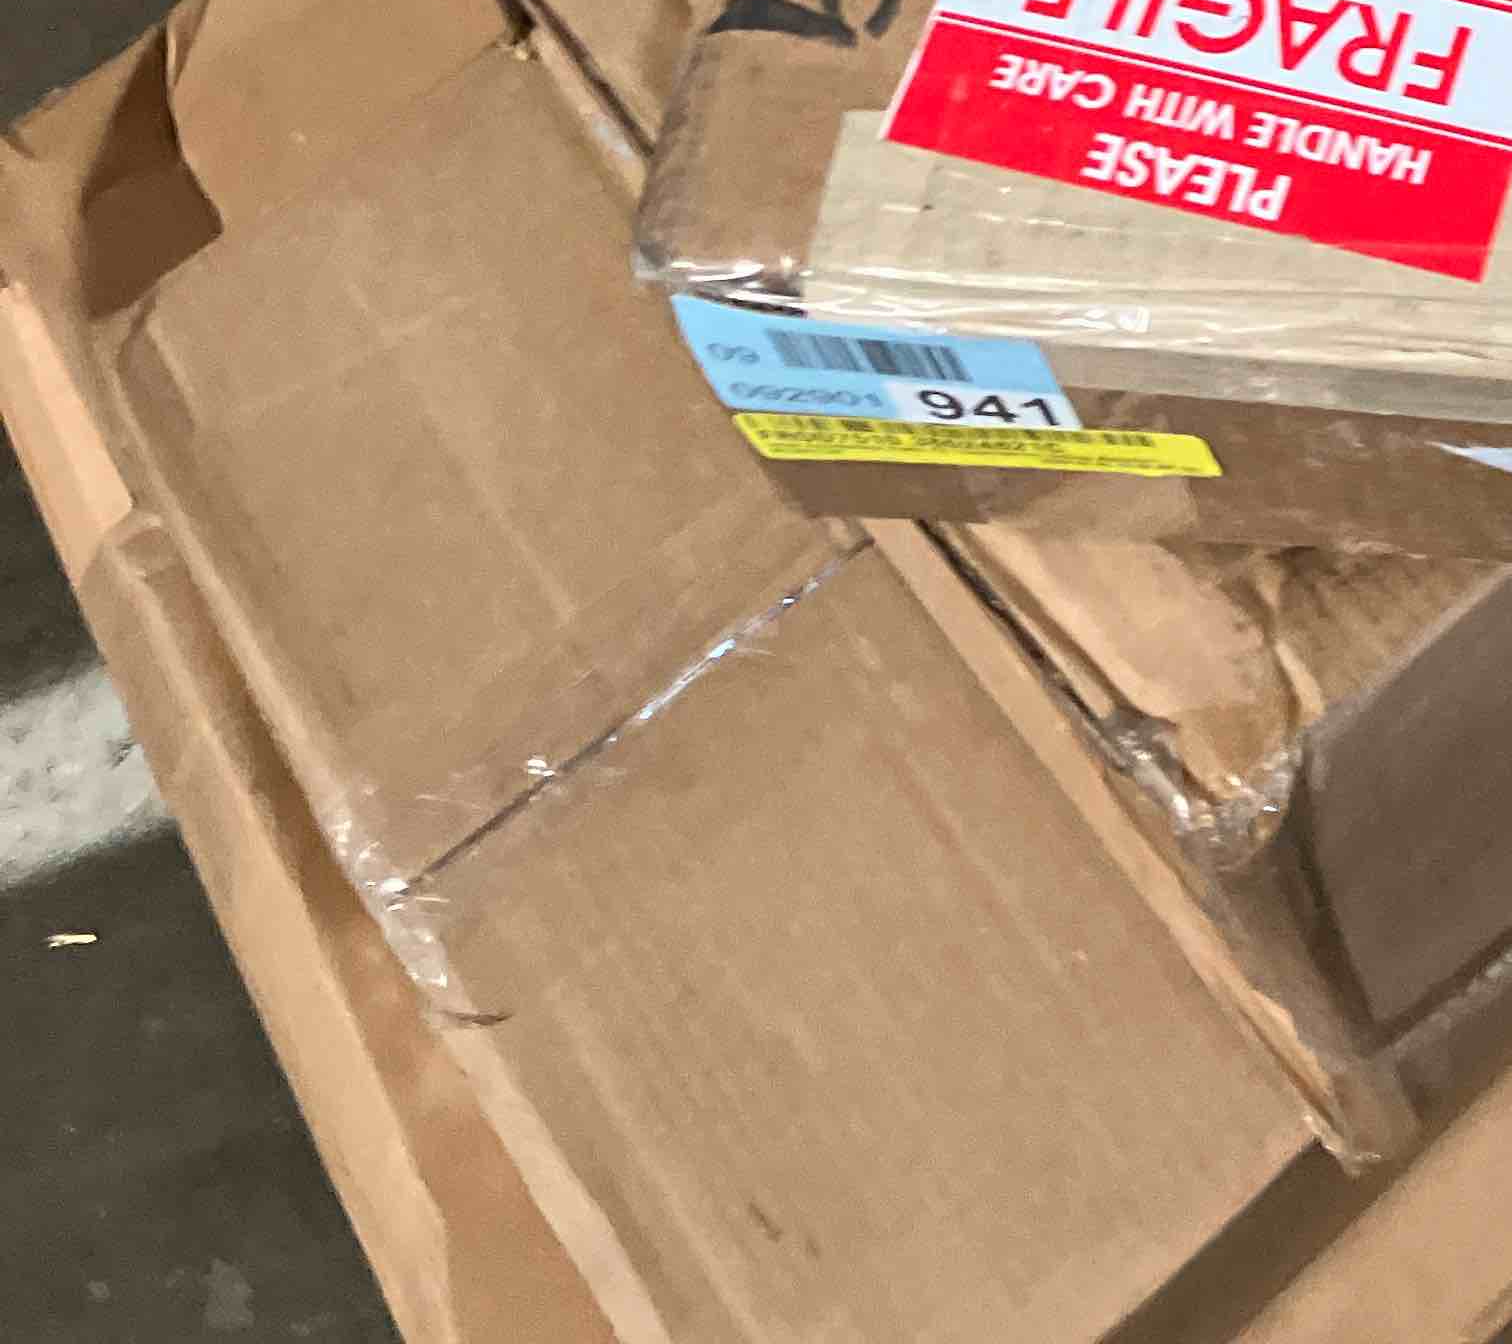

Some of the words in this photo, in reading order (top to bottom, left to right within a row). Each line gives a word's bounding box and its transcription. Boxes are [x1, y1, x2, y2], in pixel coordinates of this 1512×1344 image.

[991, 53, 1118, 110] CARE
[1125, 89, 1235, 139] WITH
[1081, 132, 1291, 221] PLEASE
[1245, 112, 1432, 185] HANDLE
[916, 389, 1062, 427] 941
